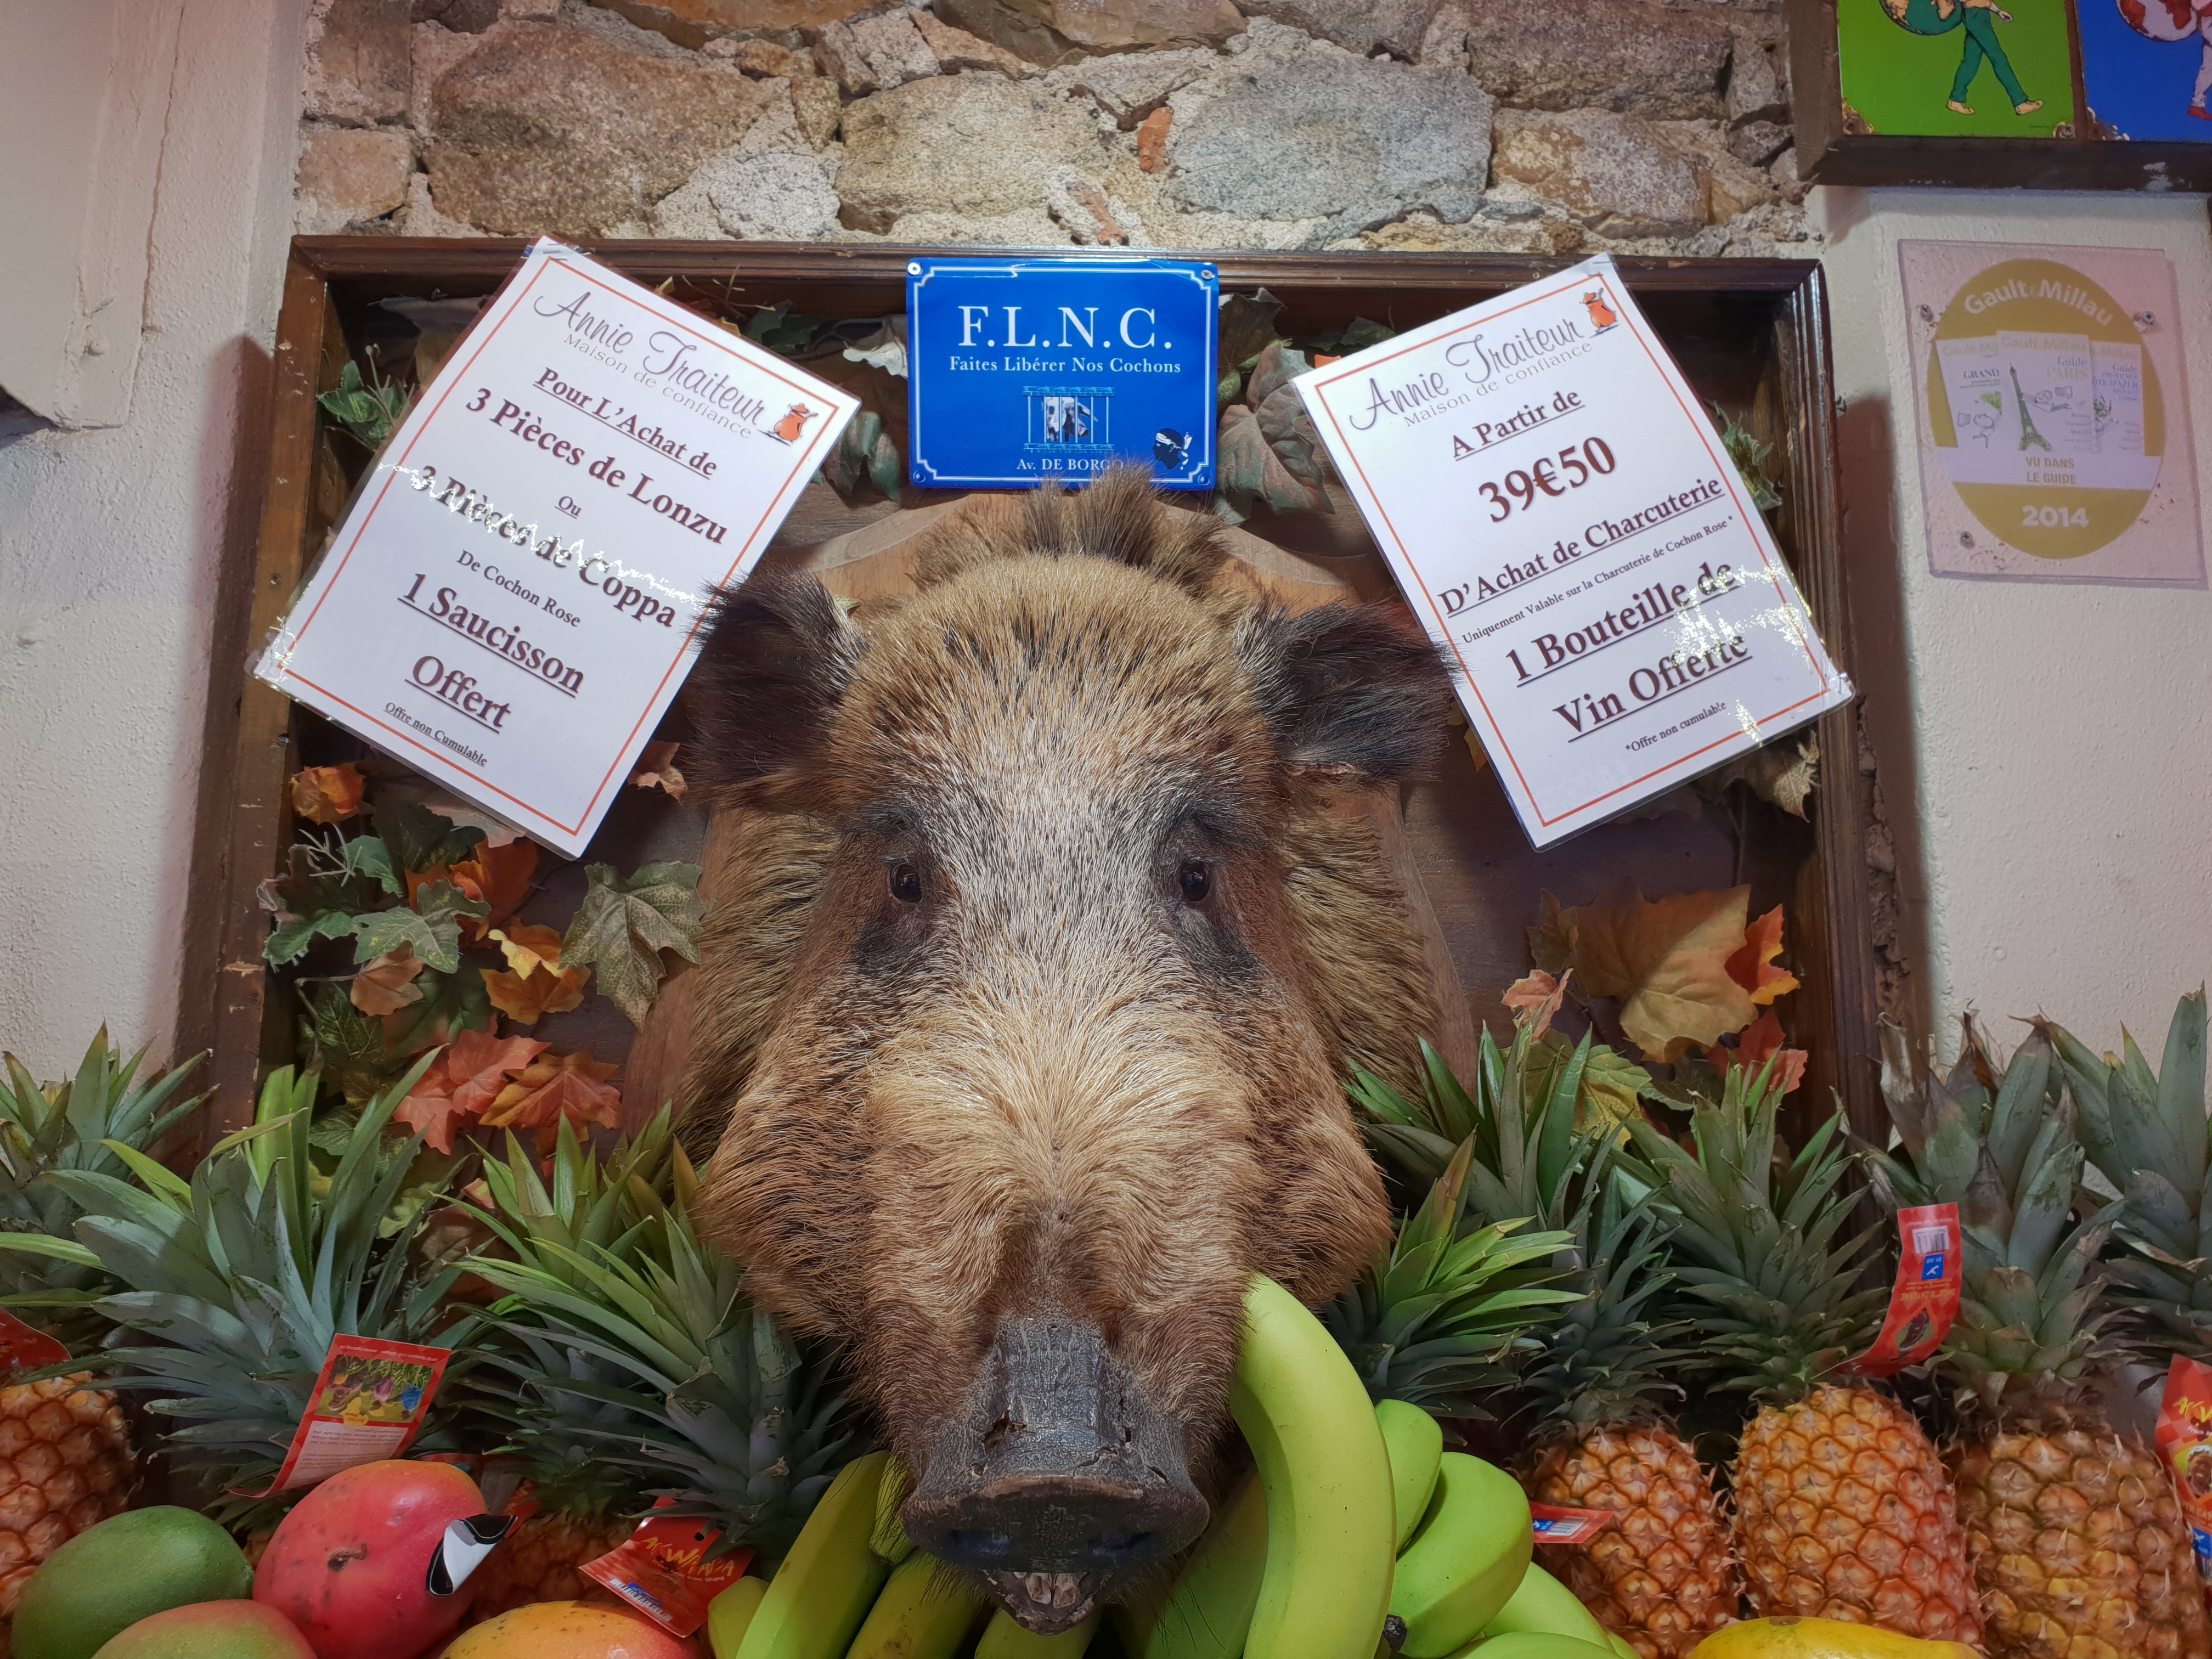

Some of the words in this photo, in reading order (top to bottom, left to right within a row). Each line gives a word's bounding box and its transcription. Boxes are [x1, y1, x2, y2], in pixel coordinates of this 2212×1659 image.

[533, 291, 634, 354] Annie
[642, 330, 765, 426] Traiteur
[949, 356, 998, 371] Faites
[1003, 356, 1066, 372] Libérer
[1071, 357, 1104, 372] Nos
[1110, 358, 1182, 373] Cochons
[957, 305, 1172, 349] F.L.N.C.
[563, 333, 628, 374] Maison
[633, 371, 657, 387] de
[662, 387, 752, 438] confiance
[1348, 372, 1449, 431] Annie
[1445, 318, 1584, 384] Traiteur
[1403, 393, 1471, 427] Maison
[1476, 381, 1498, 397] de
[1505, 342, 1593, 385] confiance
[534, 366, 593, 409] Pour
[591, 396, 687, 460] L'Achat
[689, 451, 717, 476] de
[1452, 435, 1476, 459] A
[1472, 404, 1548, 447] Partir
[1552, 391, 1582, 413] de
[2026, 457, 2041, 467] VU
[2044, 457, 2075, 468] DANS
[465, 387, 492, 412] 3
[488, 398, 585, 466] Pièces
[588, 455, 626, 488] de
[627, 472, 727, 545] Lonzu
[558, 495, 582, 517] Ou
[1016, 459, 1036, 470] Av.
[1041, 459, 1063, 470] DE
[1478, 436, 1616, 523] 39€50
[2027, 472, 2040, 483] LE
[2043, 473, 2077, 484] GUIDE
[417, 465, 437, 492] 3
[435, 476, 532, 546] Pièces
[534, 536, 572, 568] de
[578, 558, 676, 628] Coppa
[1437, 553, 1549, 615] D'Achat
[1552, 540, 1582, 565] de
[1584, 478, 1722, 548] Charcuterie
[2022, 505, 2089, 528] 2014
[456, 549, 481, 572] De
[483, 565, 540, 606] Cochon
[541, 596, 581, 628] Rose
[1461, 610, 1526, 644] Uniquement
[1524, 593, 1565, 614] Valable
[1565, 585, 1582, 599] sur
[1581, 580, 1594, 590] la
[1594, 554, 1652, 584] Charcuterie
[1652, 548, 1666, 559] de
[1665, 531, 1704, 552] Cochon
[1505, 648, 1532, 681] 1
[1530, 582, 1691, 670] Bouteille
[1697, 561, 1736, 596] de
[403, 573, 426, 603] 1
[428, 586, 584, 694] Saucisson
[412, 655, 512, 728] Offert
[1551, 693, 1627, 733] Vin
[1628, 635, 1748, 702] Offerte
[1679, 702, 1726, 730] cumulable
[385, 702, 413, 724] Offre
[412, 719, 433, 736] non
[434, 730, 488, 766] Cumulable
